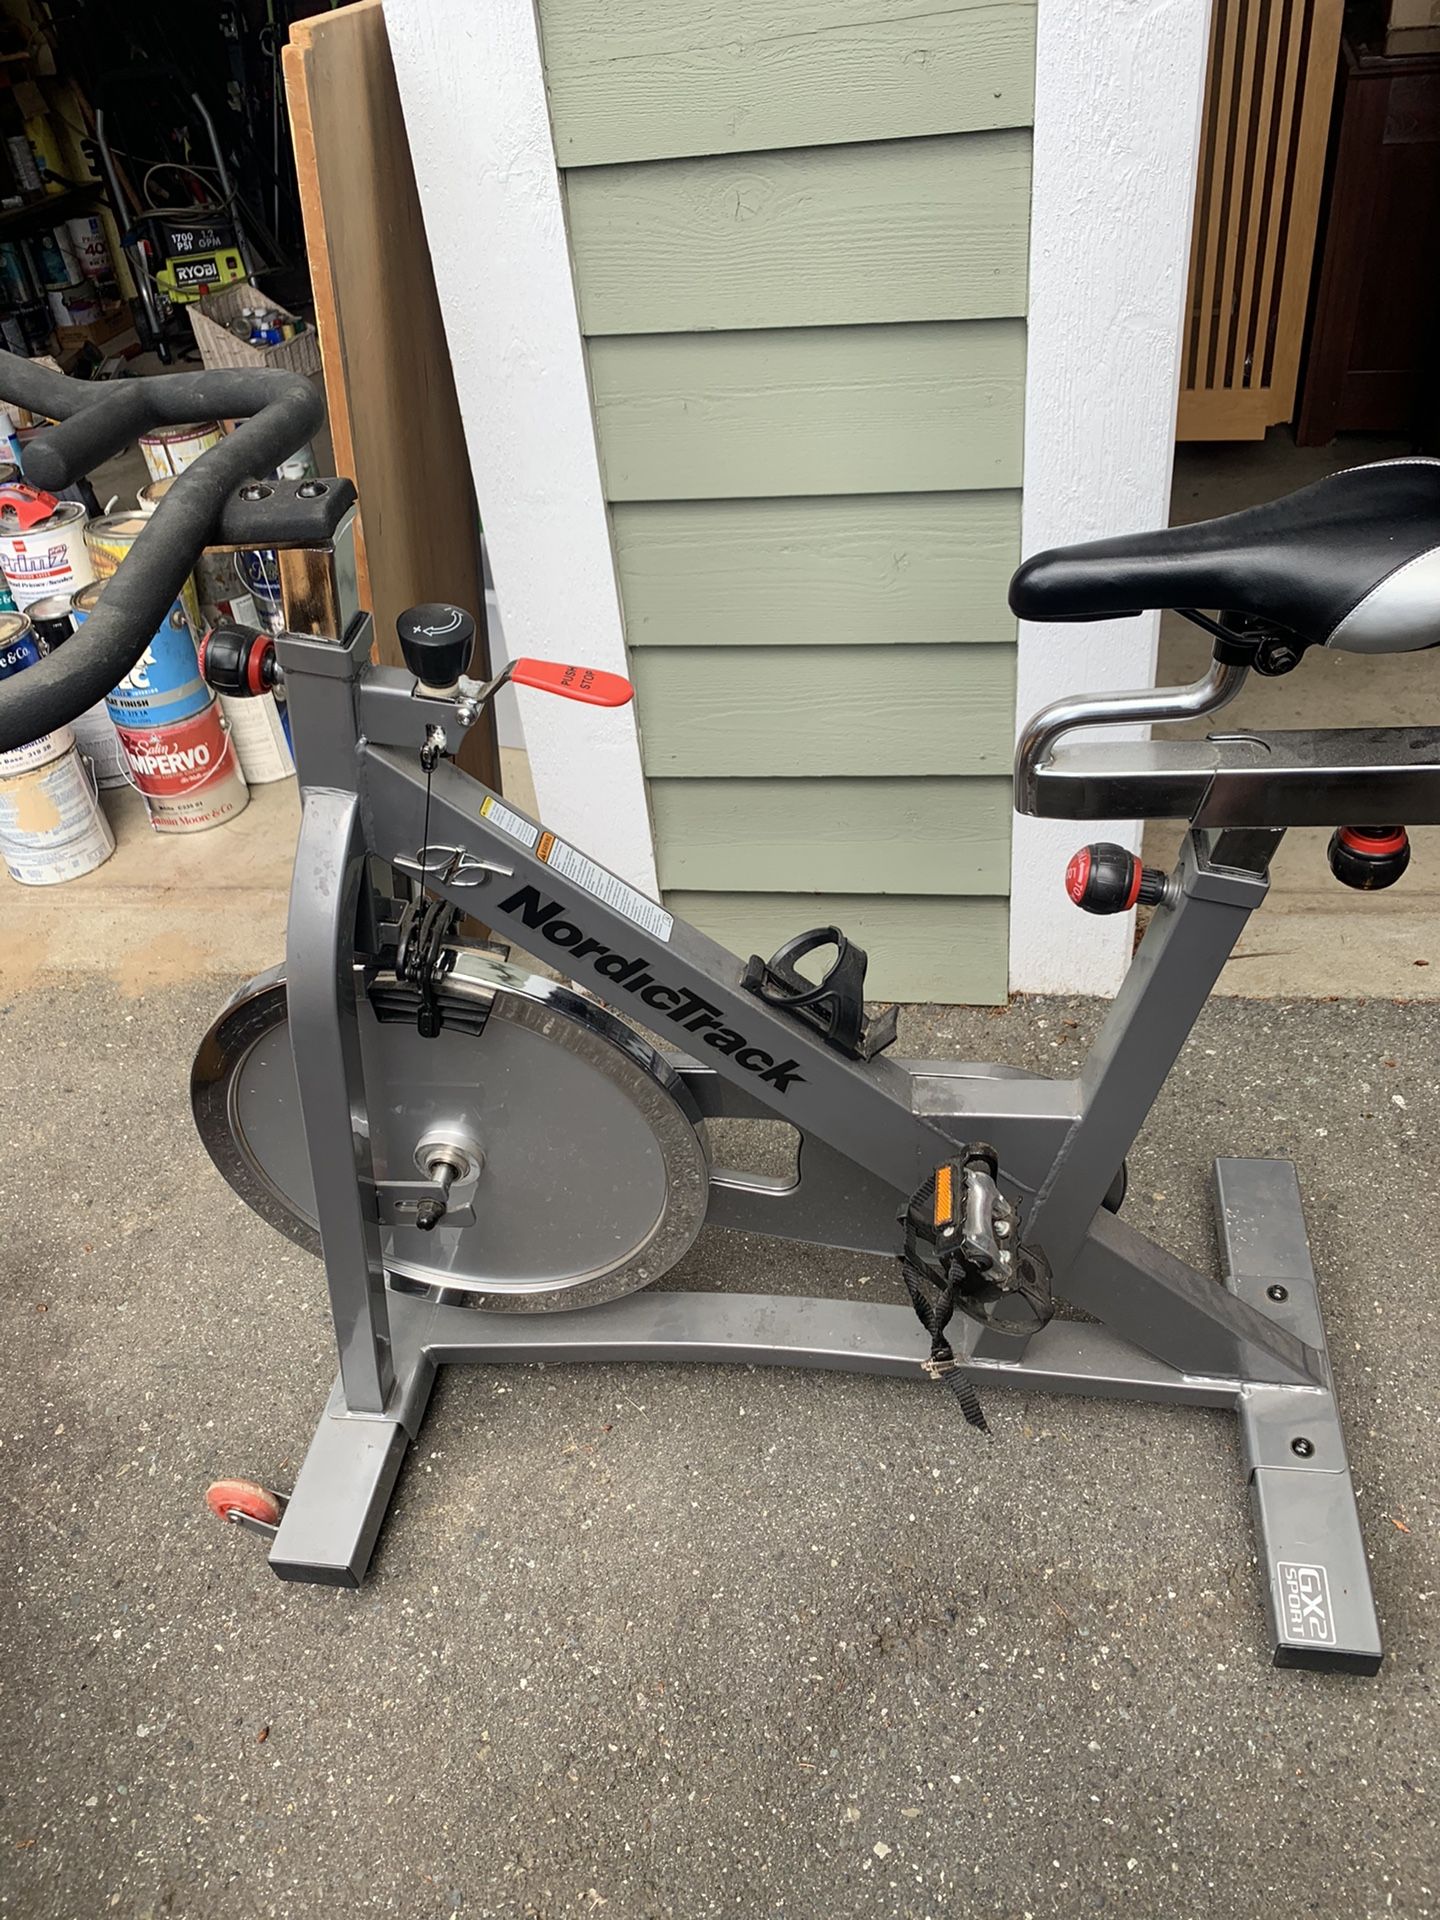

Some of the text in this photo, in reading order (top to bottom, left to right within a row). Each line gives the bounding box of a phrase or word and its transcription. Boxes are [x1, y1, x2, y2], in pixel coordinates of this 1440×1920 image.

[171, 231, 194, 244] 1700
[177, 240, 193, 252] PSI
[199, 236, 222, 248] GPM
[176, 263, 217, 280] RYOBI
[561, 665, 576, 687] PUSH
[580, 670, 595, 690] STOP
[120, 699, 149, 708] FINISH
[179, 813, 211, 826] Moore
[497, 884, 807, 1094] NordicTrack
[1284, 1567, 1306, 1637] SPORT
[1298, 1567, 1328, 1640] GX2
